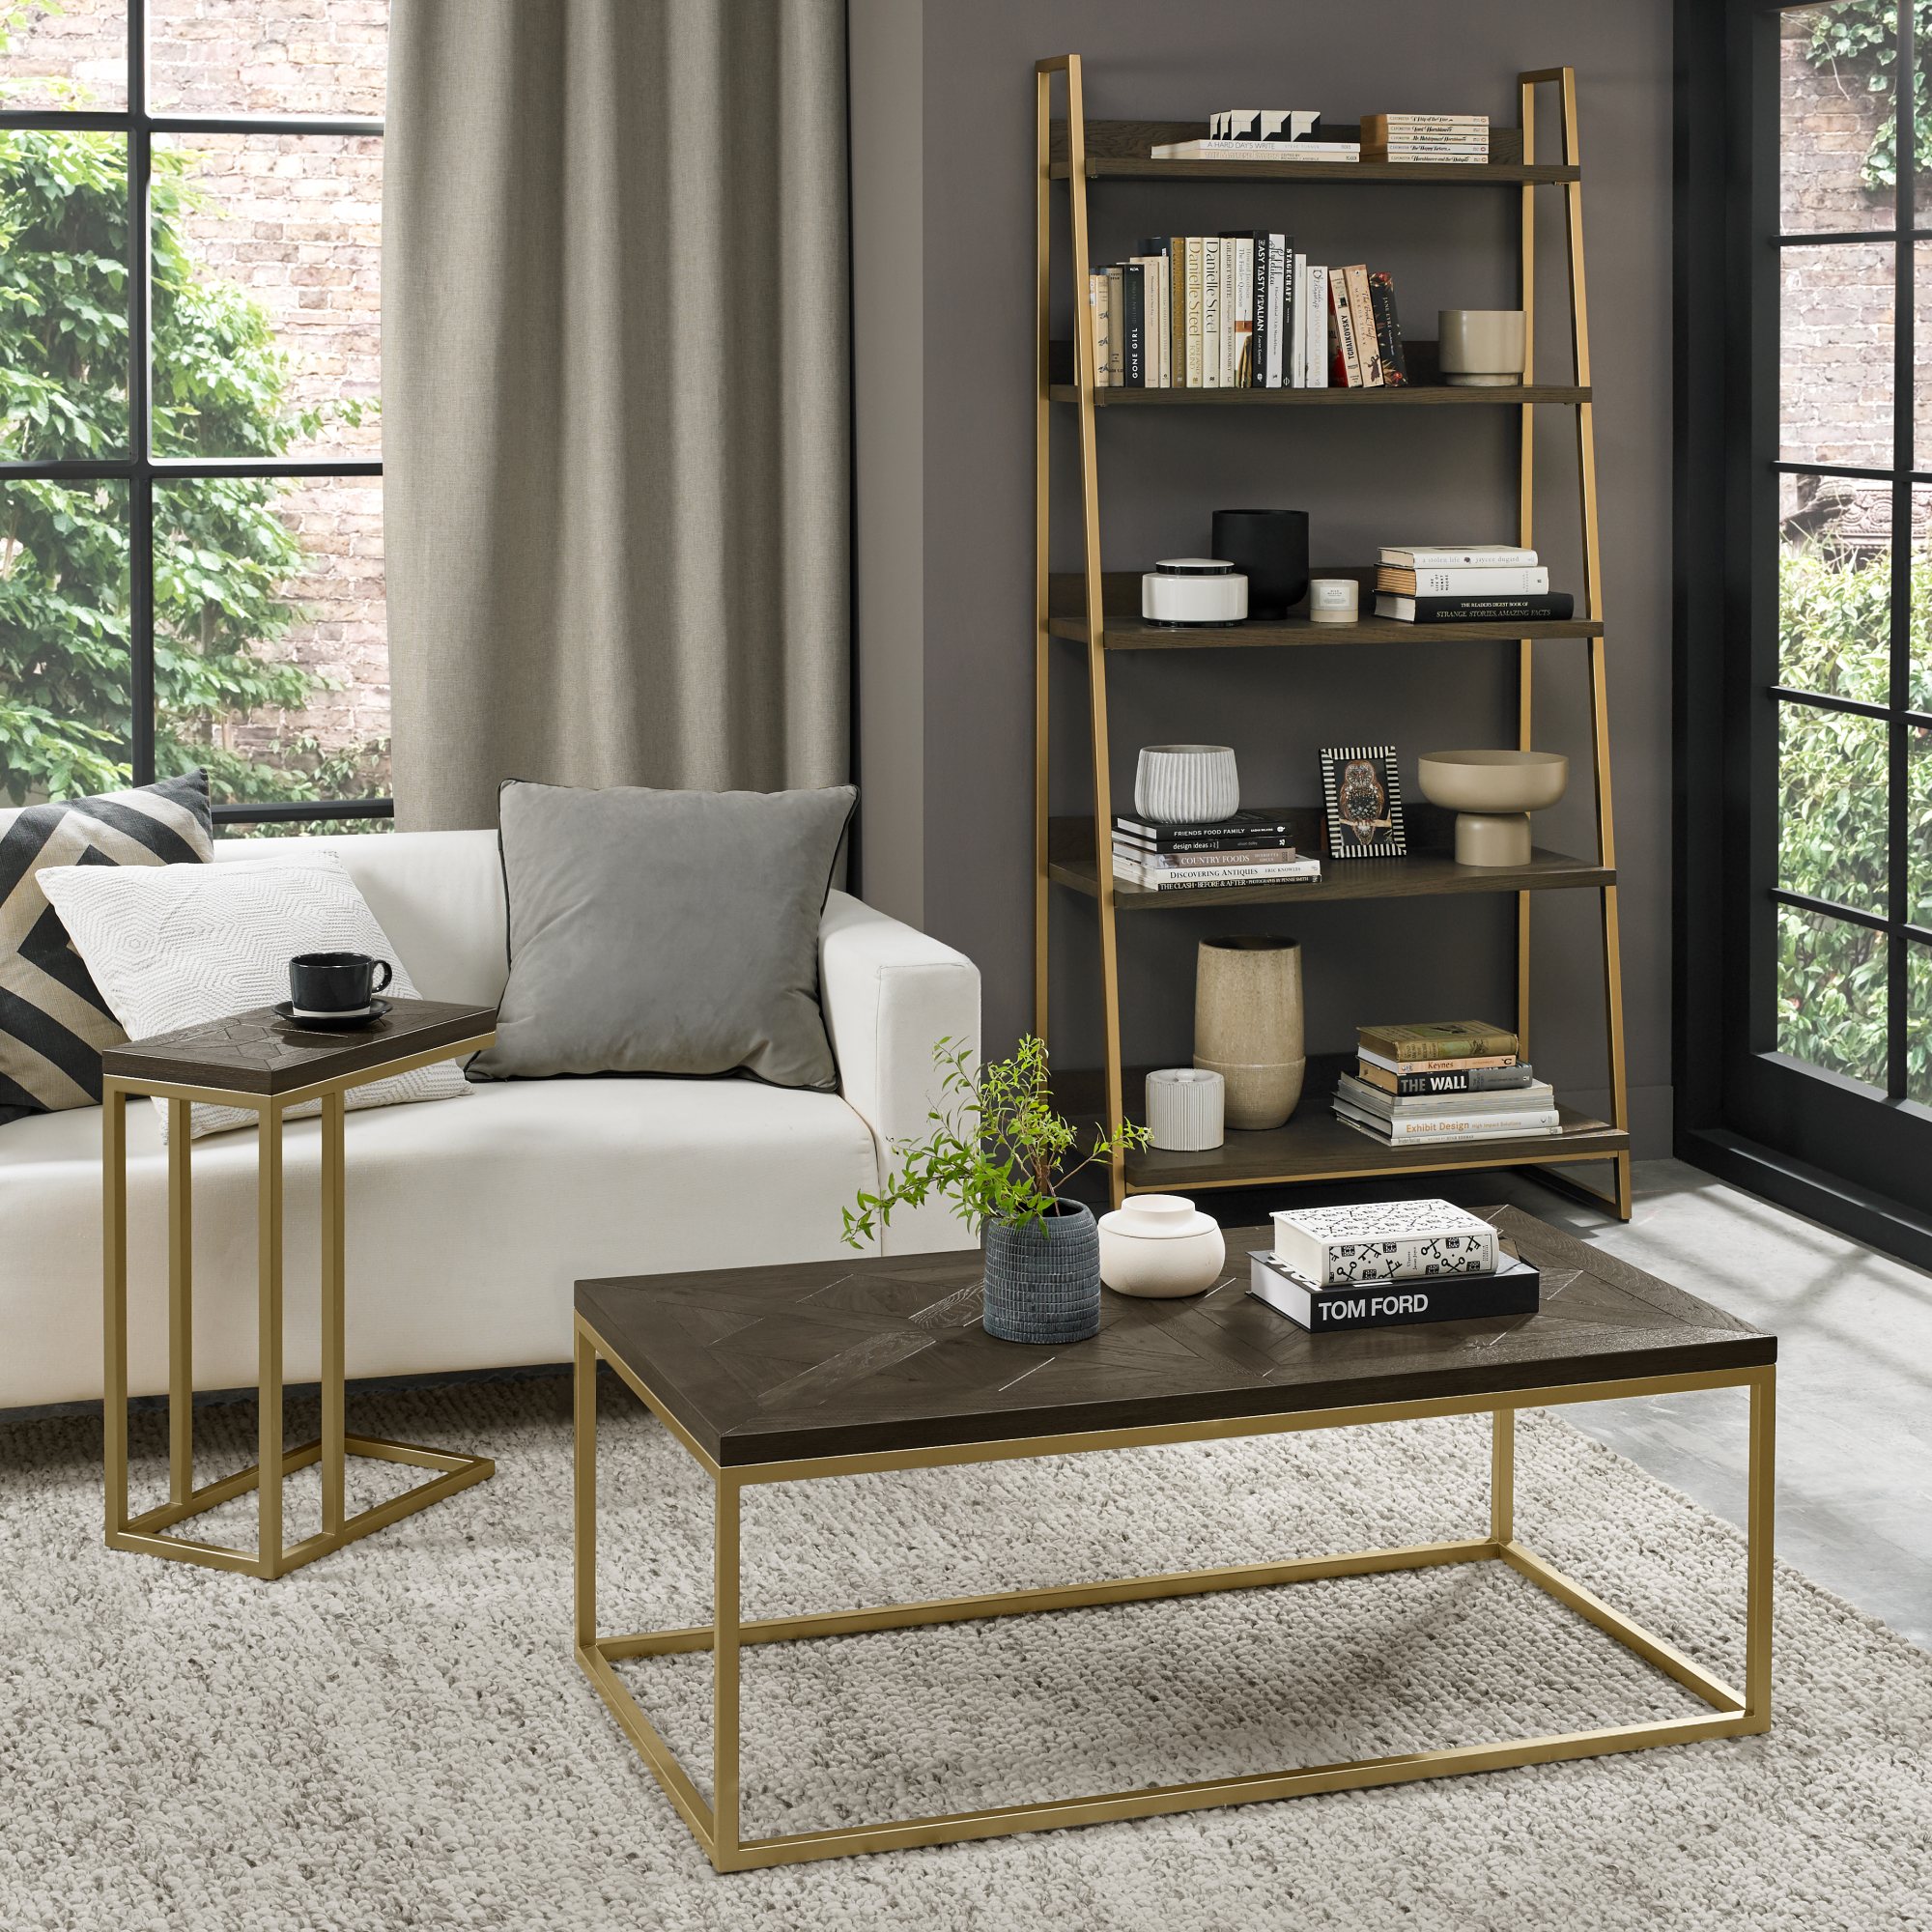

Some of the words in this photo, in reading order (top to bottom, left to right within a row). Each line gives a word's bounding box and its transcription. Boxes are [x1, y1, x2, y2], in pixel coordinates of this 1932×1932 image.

[1257, 240, 1266, 263] EASY
[1188, 241, 1202, 298] Danielle
[1205, 241, 1219, 296] Danielle
[1257, 264, 1265, 293] TASTY
[1382, 297, 1390, 312] JANE
[1188, 301, 1201, 336] Steel
[1205, 299, 1218, 334] Steel
[1340, 315, 1355, 360] TCHAIKOVSKY
[1497, 556, 1520, 564] dugard
[1181, 856, 1221, 864] COUNTRY
[1170, 870, 1220, 879] DISCOVERING
[1222, 868, 1258, 877] ANTIQUES
[1160, 882, 1173, 890] THE
[1173, 881, 1195, 890] CLASH
[1197, 880, 1220, 888] BEFORE
[1428, 1061, 1454, 1070] Keynes
[1400, 1078, 1426, 1093] THE
[1430, 1075, 1467, 1091] WALL
[1406, 1123, 1437, 1133] Exhibit
[1439, 1121, 1469, 1132] Design
[1318, 1298, 1366, 1322] TOM
[1370, 1293, 1429, 1317] FORD
